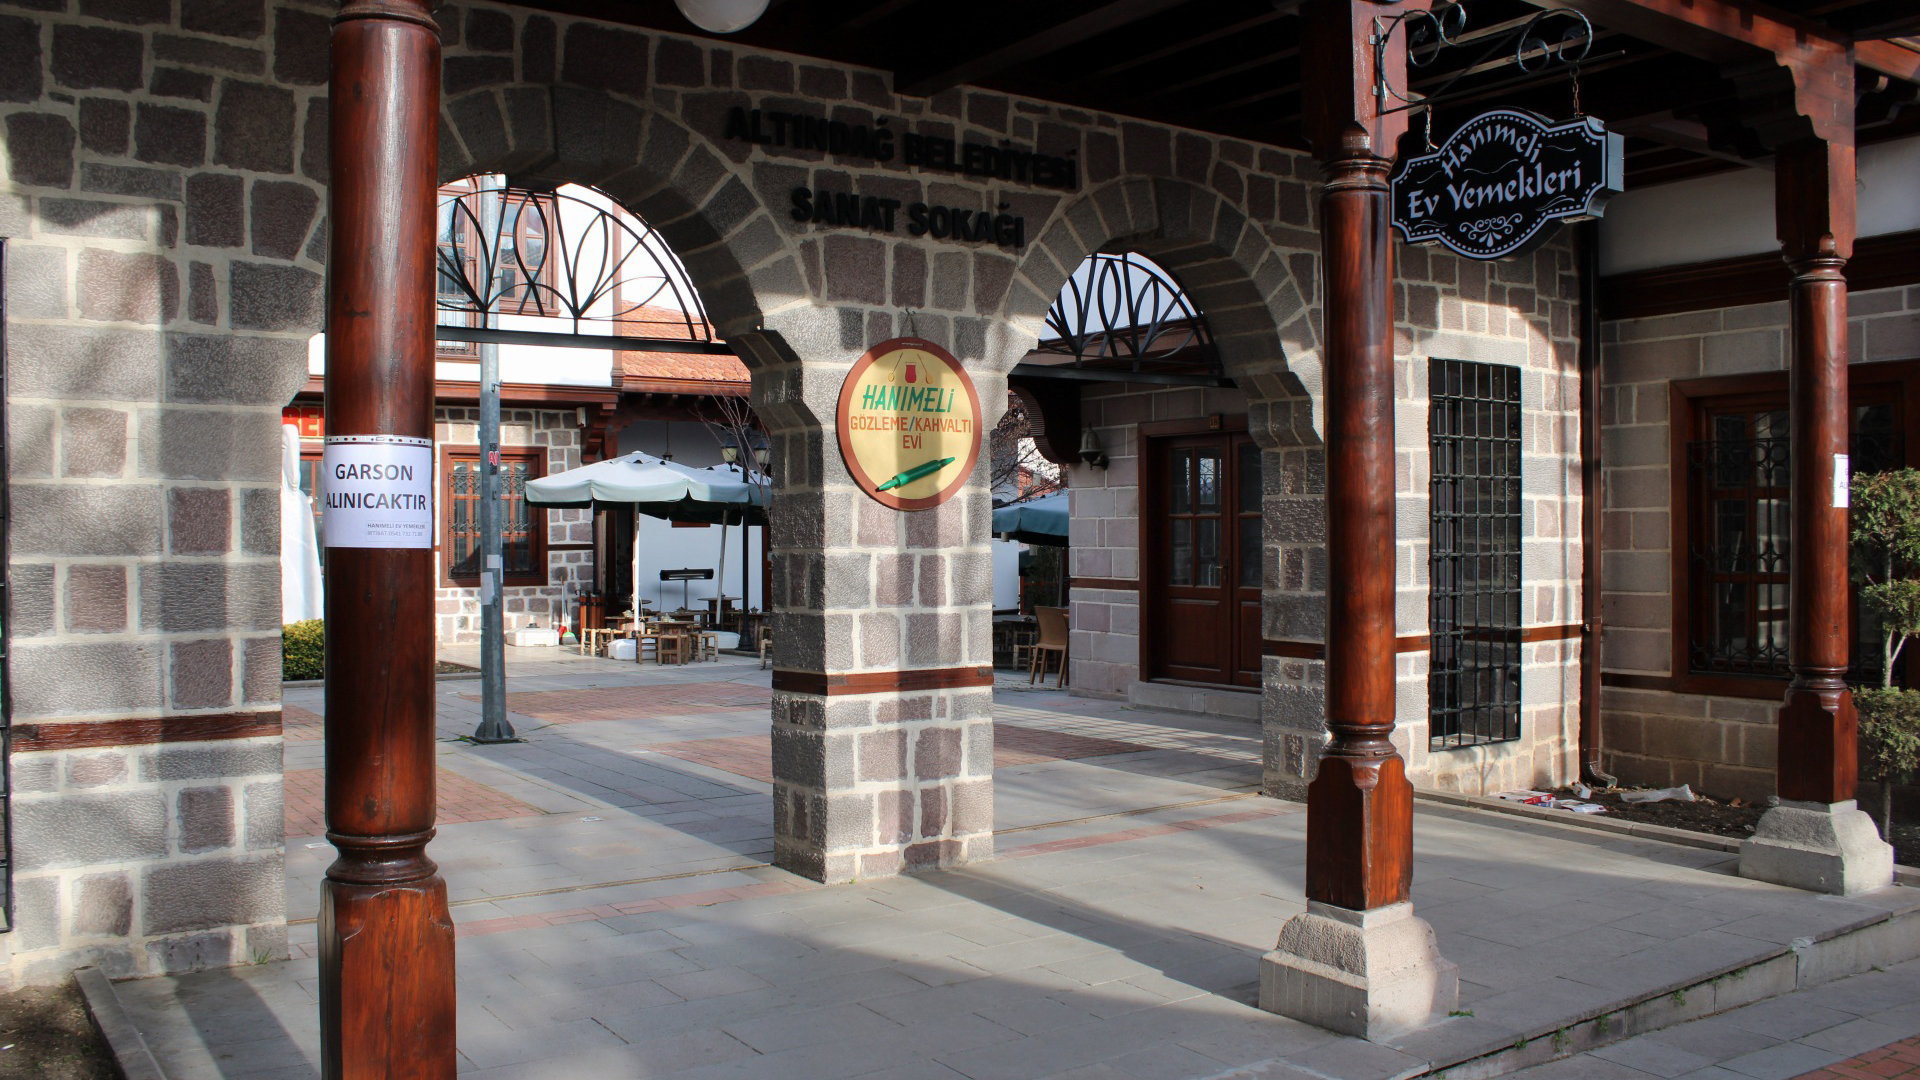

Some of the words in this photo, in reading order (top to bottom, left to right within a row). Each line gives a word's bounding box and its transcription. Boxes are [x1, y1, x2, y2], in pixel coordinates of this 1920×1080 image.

[725, 106, 895, 161] ALTINDAĞ
[904, 133, 1077, 189] BELEDİYESİ
[1407, 189, 1439, 219] Ev
[1446, 159, 1582, 212] Yemekleri
[790, 187, 901, 233] SANAT
[908, 202, 1025, 248] SOKAĞI
[902, 433, 922, 449] EVİ
[335, 463, 413, 481] GARSON
[326, 492, 426, 510] ALINICAKTIR
